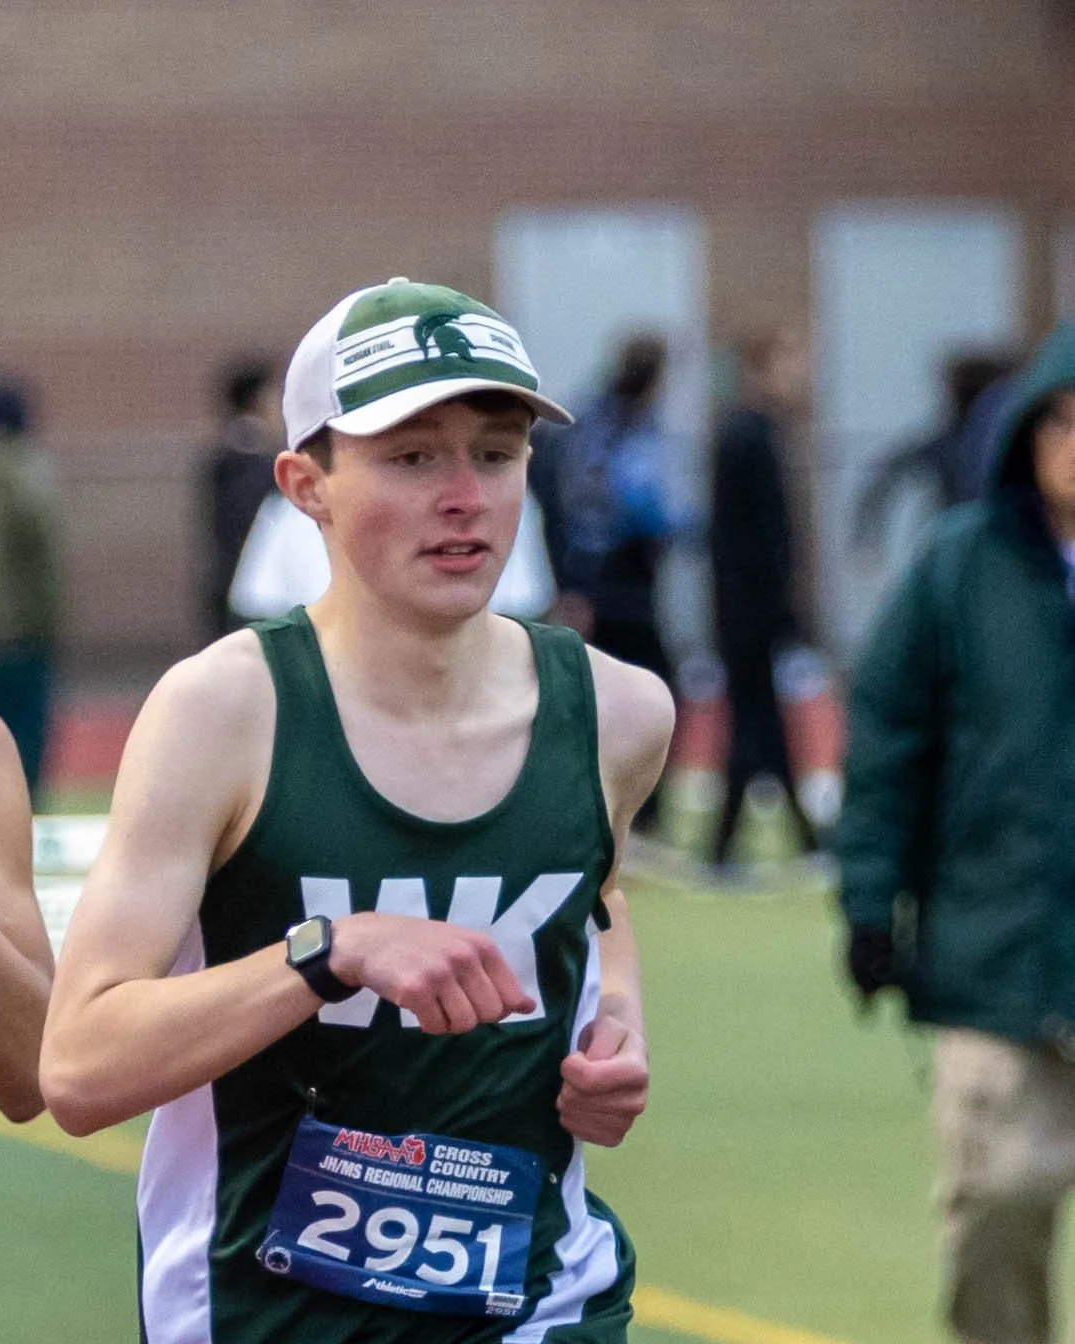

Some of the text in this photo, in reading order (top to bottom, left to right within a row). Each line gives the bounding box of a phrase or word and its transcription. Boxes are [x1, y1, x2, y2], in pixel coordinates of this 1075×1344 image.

[300, 872, 584, 1028] WK
[332, 1128, 423, 1166] MHSAA
[433, 1144, 493, 1166] CROSS
[319, 1155, 362, 1179] JH/MS
[364, 1167, 423, 1192] REGIONAL
[426, 1178, 514, 1206] CHAMPIONSHIP
[429, 1160, 511, 1185] COUNTRY
[297, 1190, 503, 1292] 2951
